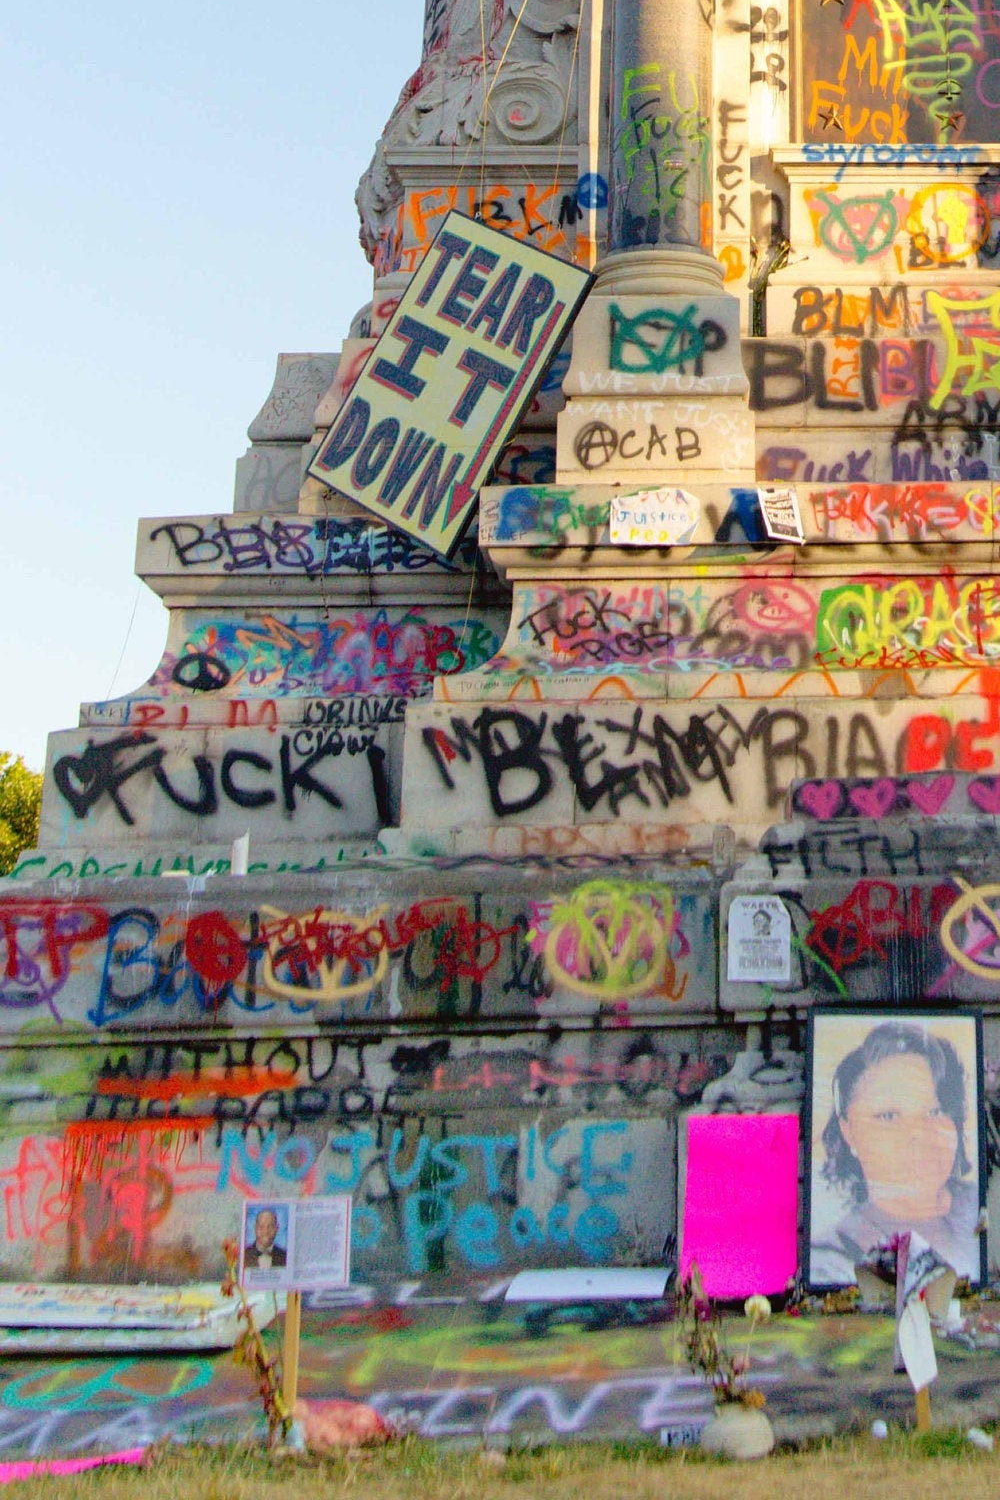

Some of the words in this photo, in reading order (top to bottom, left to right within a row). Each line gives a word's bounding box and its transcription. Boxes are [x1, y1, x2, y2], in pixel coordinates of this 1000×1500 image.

[716, 100, 748, 231] FUCK
[414, 229, 558, 359] TEAR
[793, 282, 909, 337] BLM
[368, 314, 517, 429] IT
[566, 401, 664, 423] WANT
[578, 371, 638, 393] WE
[650, 372, 736, 392] JUST
[316, 395, 466, 532] DOWN
[217, 1128, 315, 1193] NO
[327, 1121, 633, 1196] JUSTICE
